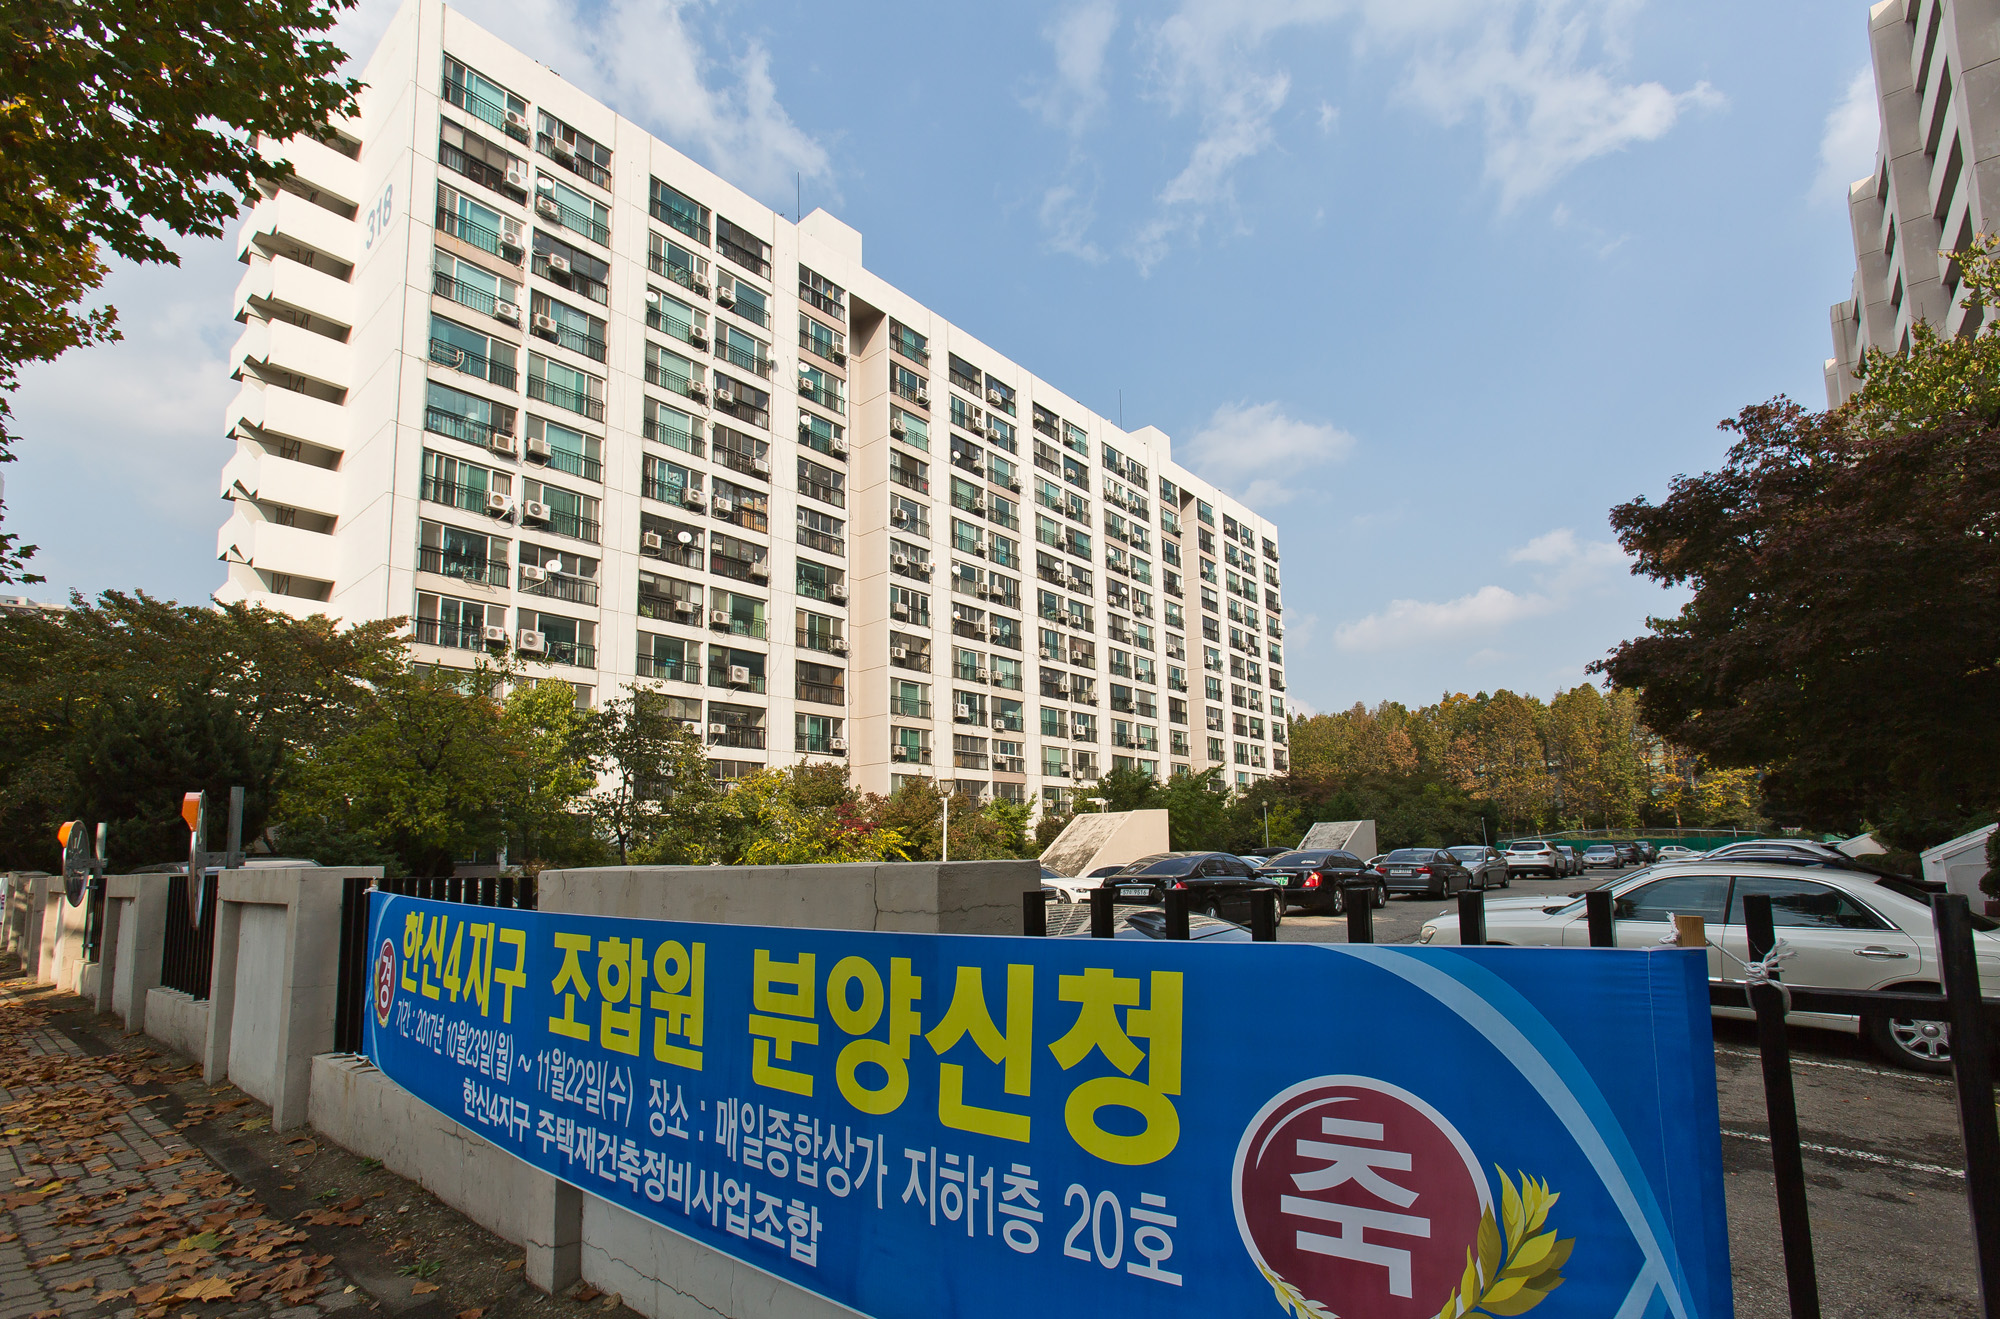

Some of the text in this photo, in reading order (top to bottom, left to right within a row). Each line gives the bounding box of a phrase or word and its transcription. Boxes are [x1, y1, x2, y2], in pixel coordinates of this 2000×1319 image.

[365, 183, 393, 250] 318
[380, 955, 393, 1009] 경
[401, 911, 1184, 1166] 한신4지구 조합원 분양신청
[396, 998, 411, 1039] 기간
[415, 1008, 445, 1055] 2017년
[446, 1019, 513, 1084] 10월23일(월)
[537, 1048, 633, 1128] 11월22일(수)
[648, 1077, 689, 1140] 장소
[716, 1097, 888, 1210] 매일종합상가
[901, 1146, 1044, 1254] 지하1층
[1063, 1183, 1183, 1287] 20호
[463, 1077, 823, 1268] 한신4지구 주택재건축정비사업조합
[1281, 1116, 1431, 1299] 축
